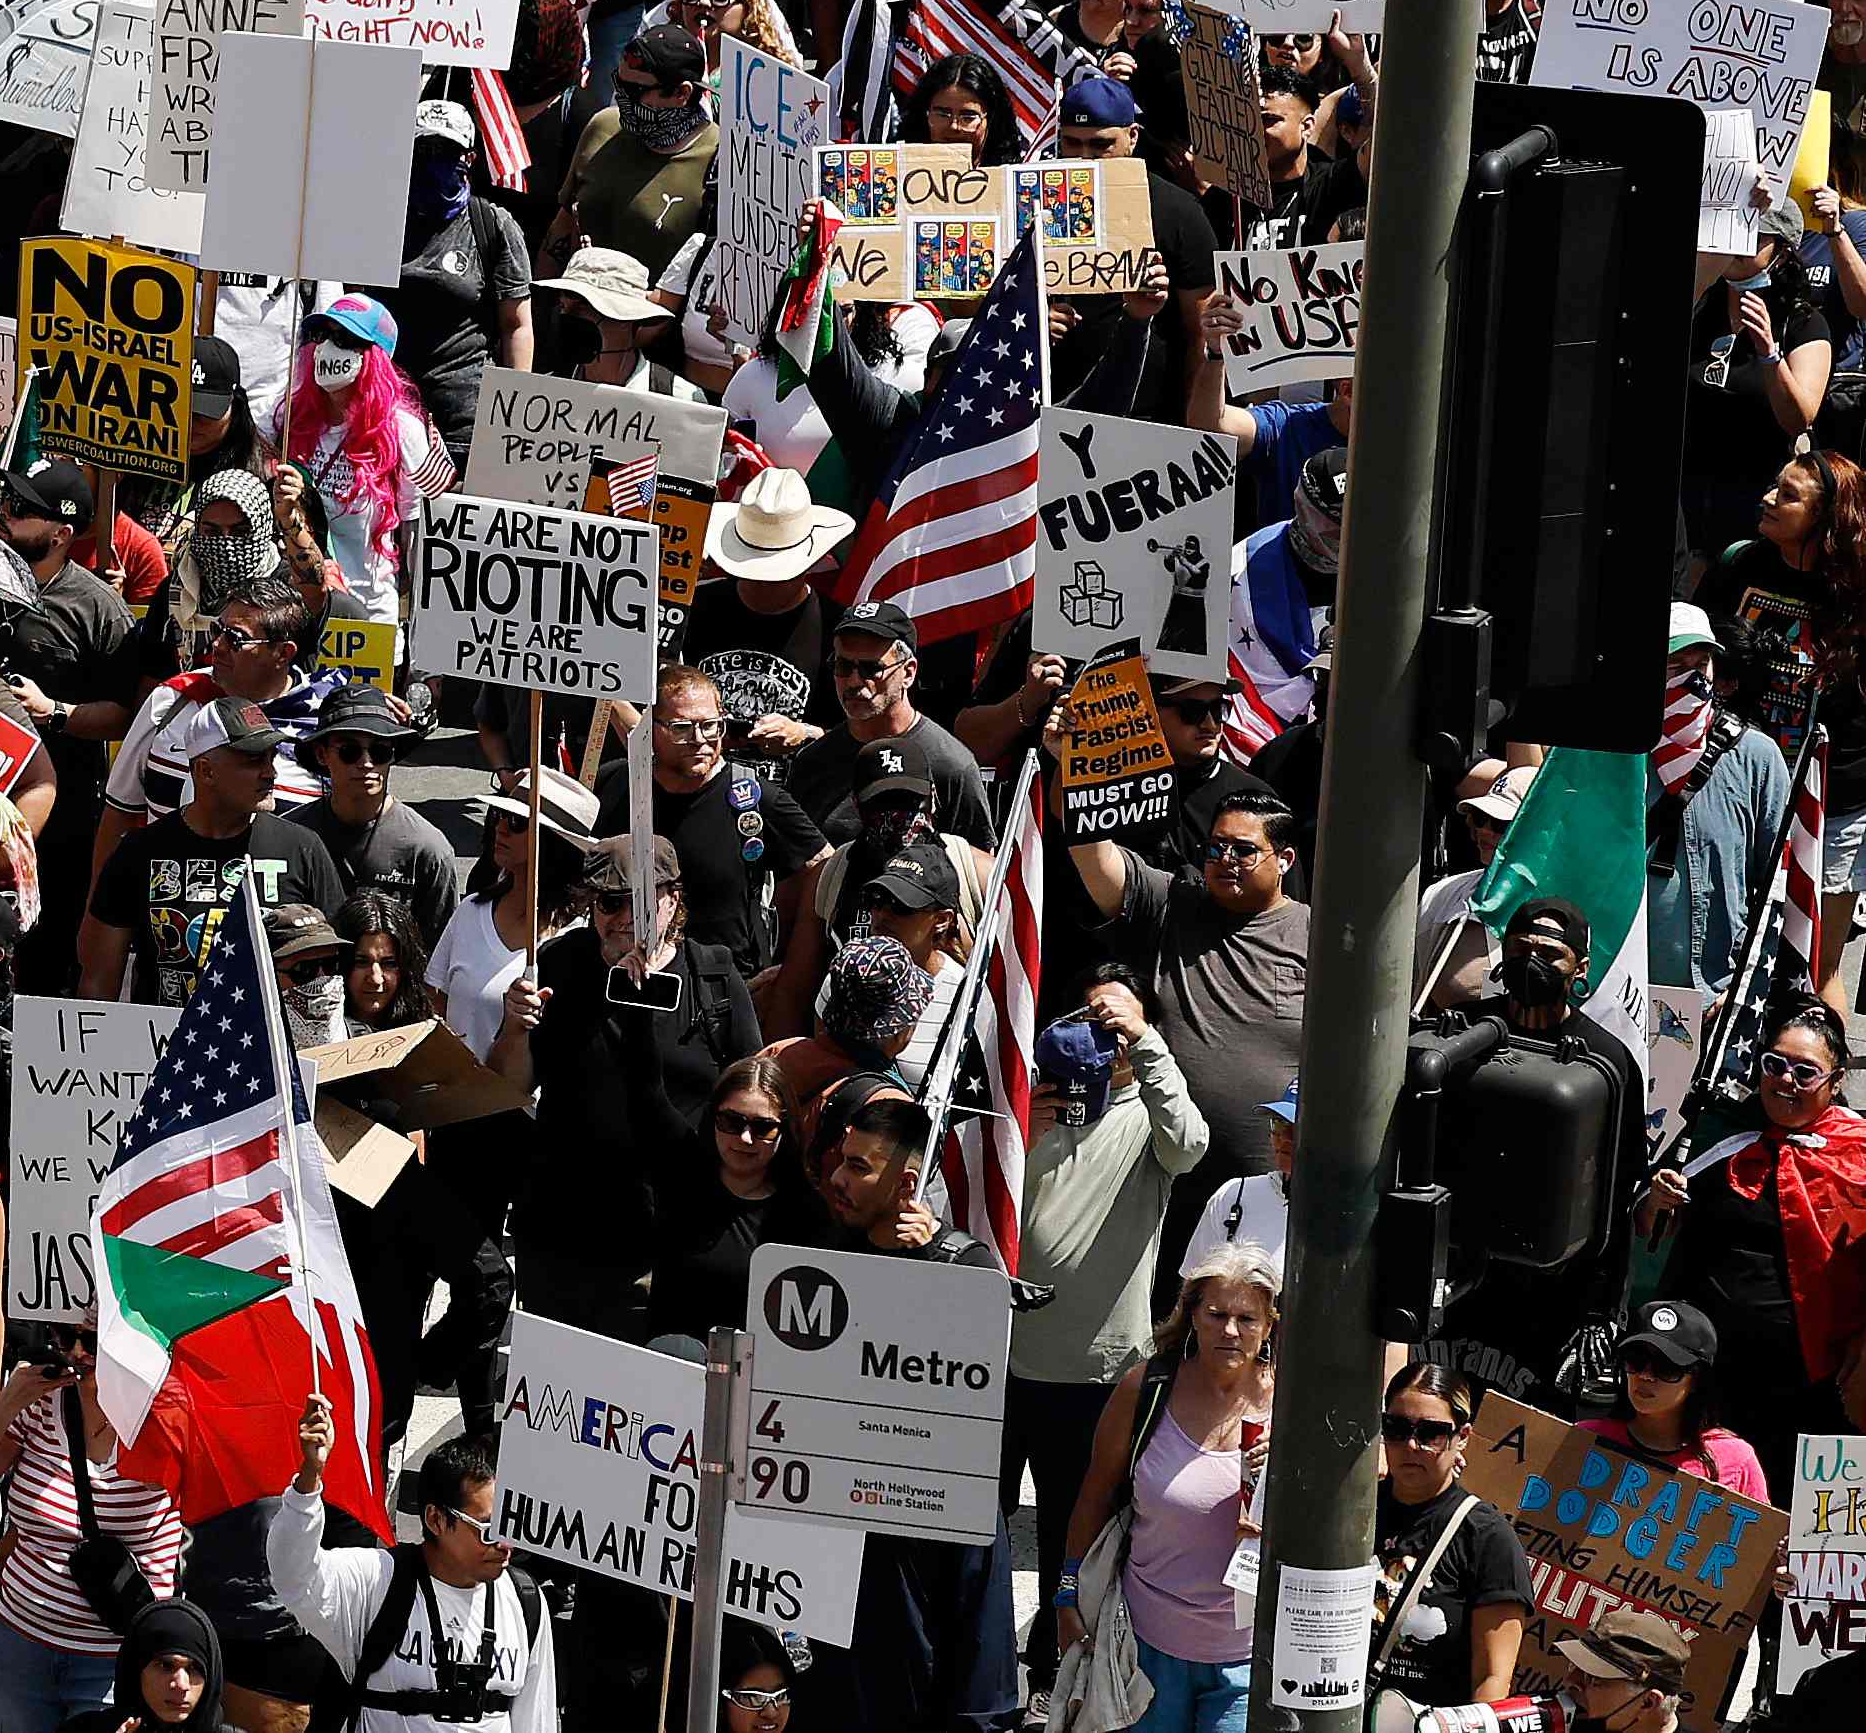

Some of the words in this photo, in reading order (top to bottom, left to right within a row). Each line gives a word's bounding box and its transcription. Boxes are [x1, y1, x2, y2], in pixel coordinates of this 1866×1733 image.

[1605, 43, 1660, 87] IS
[1666, 57, 1810, 126] ABOVE
[26, 249, 187, 338] NO
[29, 315, 182, 368] US-ISRAEL
[35, 349, 181, 425] WAR
[85, 412, 181, 460] IRAN!
[1057, 422, 1098, 480] Y
[421, 496, 476, 539] WE
[492, 510, 561, 551] ARE
[569, 518, 651, 567] NOT
[418, 535, 651, 634] RIOTING
[454, 639, 624, 694] PATRIOTS
[1073, 688, 1141, 722] Trump
[1070, 713, 1156, 751] Fascist
[1069, 740, 1166, 778] Regime
[1068, 780, 1134, 811] MUST
[1138, 772, 1173, 800] GO
[1075, 795, 1170, 837] NOW!!!
[859, 1339, 991, 1392] Metro
[754, 1399, 786, 1444] 4
[857, 1419, 890, 1435] Santa
[892, 1423, 932, 1439] Monica
[750, 1455, 811, 1505] 90
[853, 1478, 885, 1493] North
[888, 1481, 946, 1500] Hollywood
[878, 1494, 903, 1508] Line
[904, 1496, 944, 1513] Station
[1578, 1447, 1762, 1550] DRAFT
[498, 1486, 647, 1578] HUMAN
[1516, 1472, 1741, 1590] DODGER
